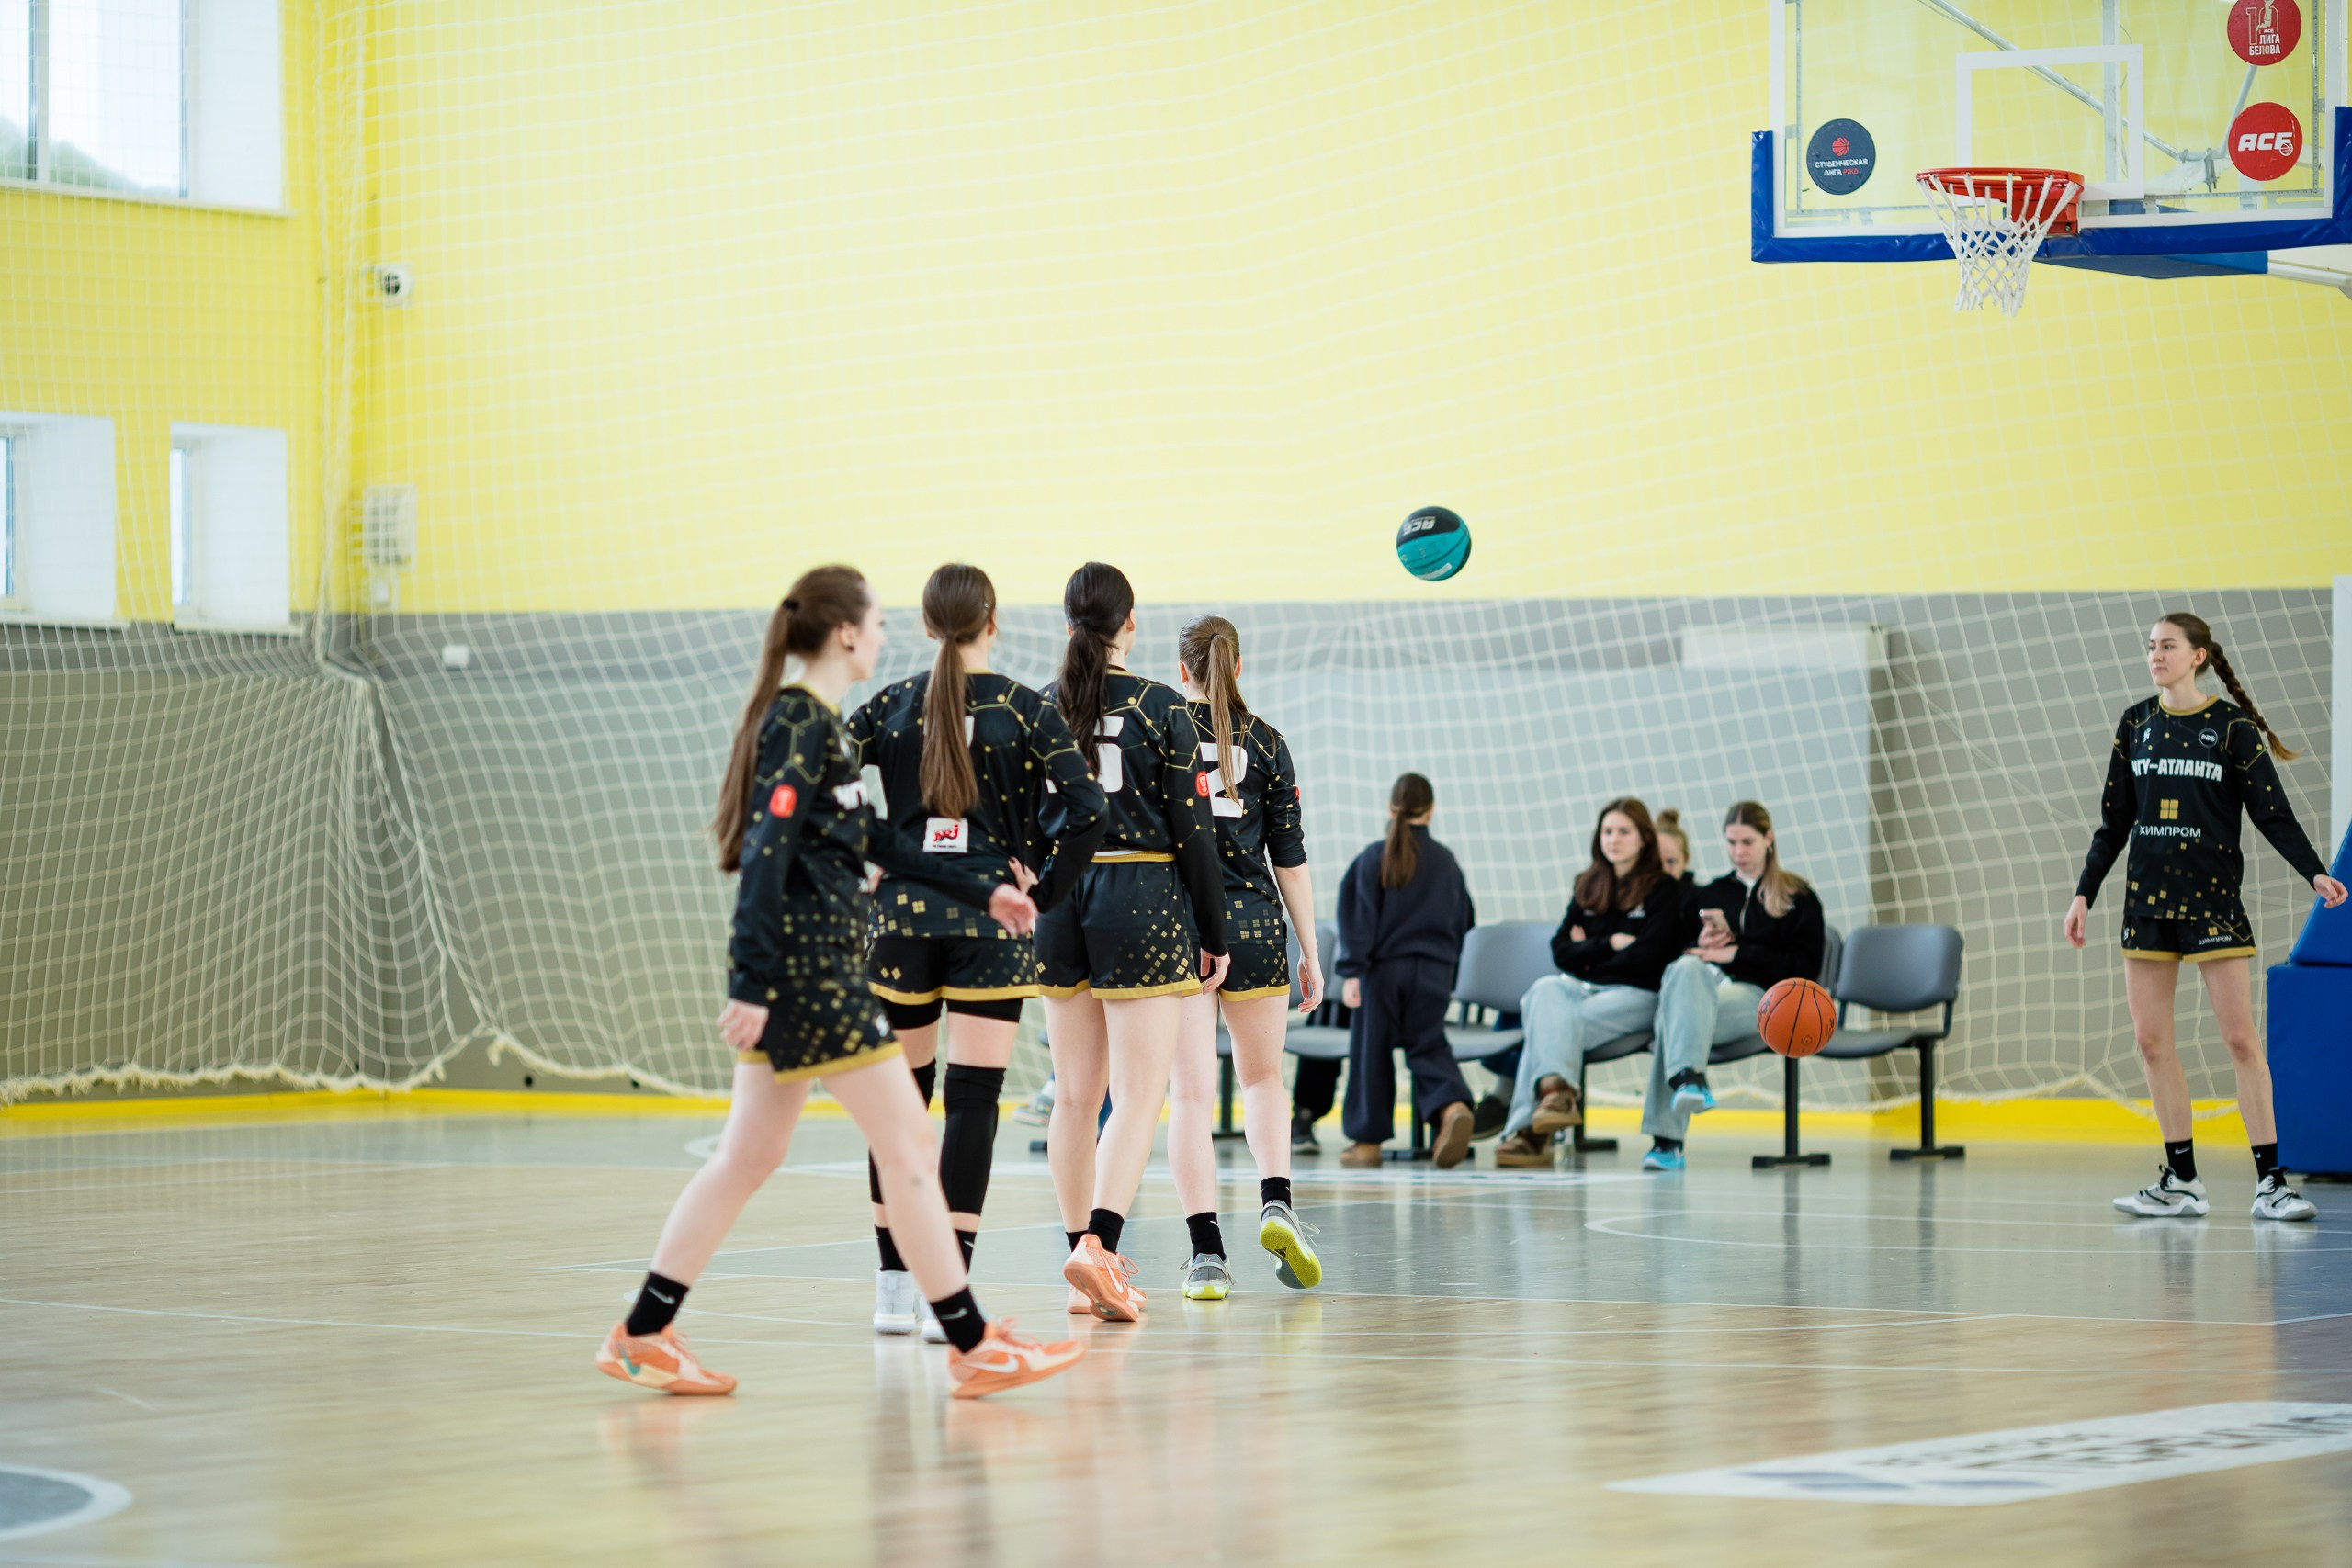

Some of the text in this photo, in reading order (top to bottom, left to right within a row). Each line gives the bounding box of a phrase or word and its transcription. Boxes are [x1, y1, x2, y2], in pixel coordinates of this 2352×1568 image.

[2260, 34, 2280, 45] ЛИГА
[2238, 132, 2293, 152] АСБ
[1815, 158, 1869, 168] СТУДЕНЧЕСКАЯ
[1824, 168, 1842, 176] ЛИГА
[2139, 826, 2201, 838] ХИМПРОМ
